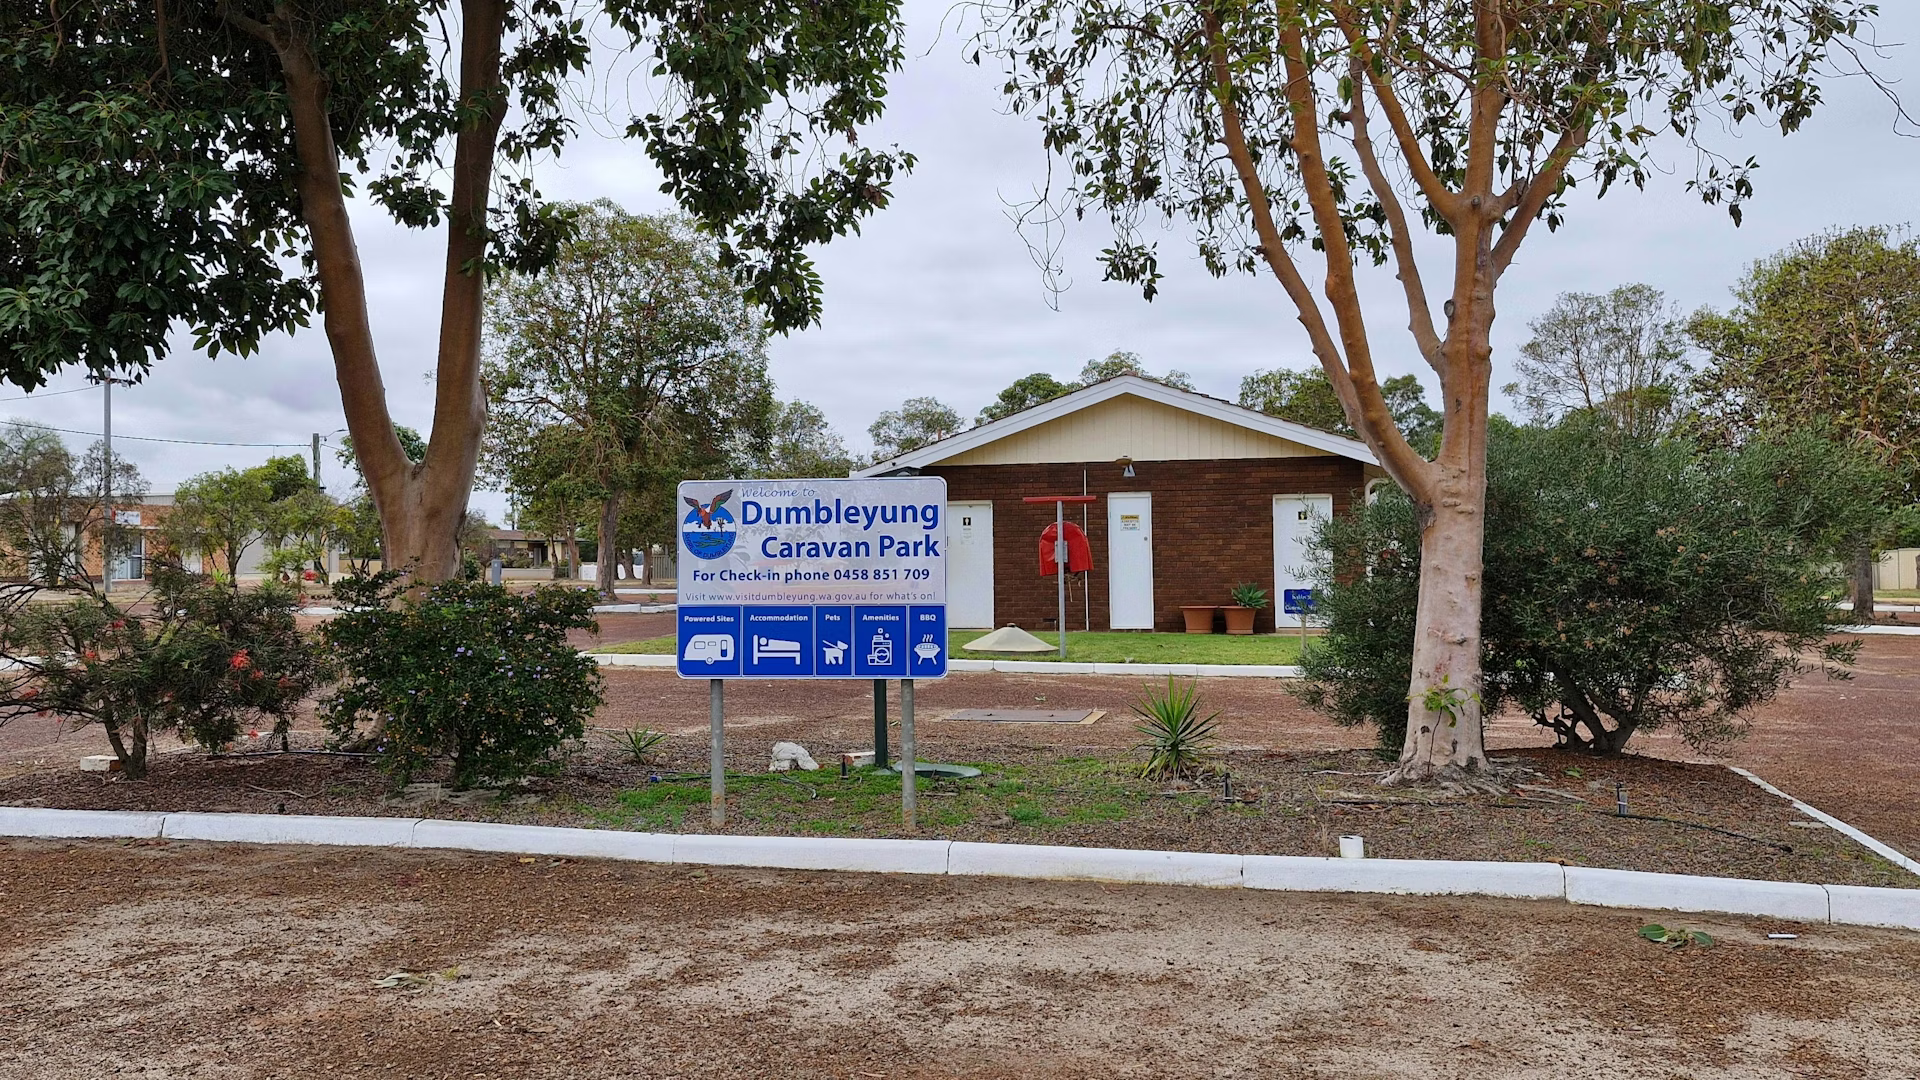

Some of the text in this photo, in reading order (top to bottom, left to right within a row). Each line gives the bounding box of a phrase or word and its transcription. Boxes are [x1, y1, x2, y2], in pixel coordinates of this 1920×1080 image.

[741, 487, 817, 498] Welcome to
[741, 498, 939, 531] Dumbleyung
[761, 534, 940, 558] Caravan Park
[693, 569, 930, 584] For Check-in phone 0458 851 709
[685, 591, 936, 602] Visit www.visitdumbleyung.wa.gov.au for what's on!
[750, 614, 809, 622] Accommodation
[919, 614, 937, 622] BBQ
